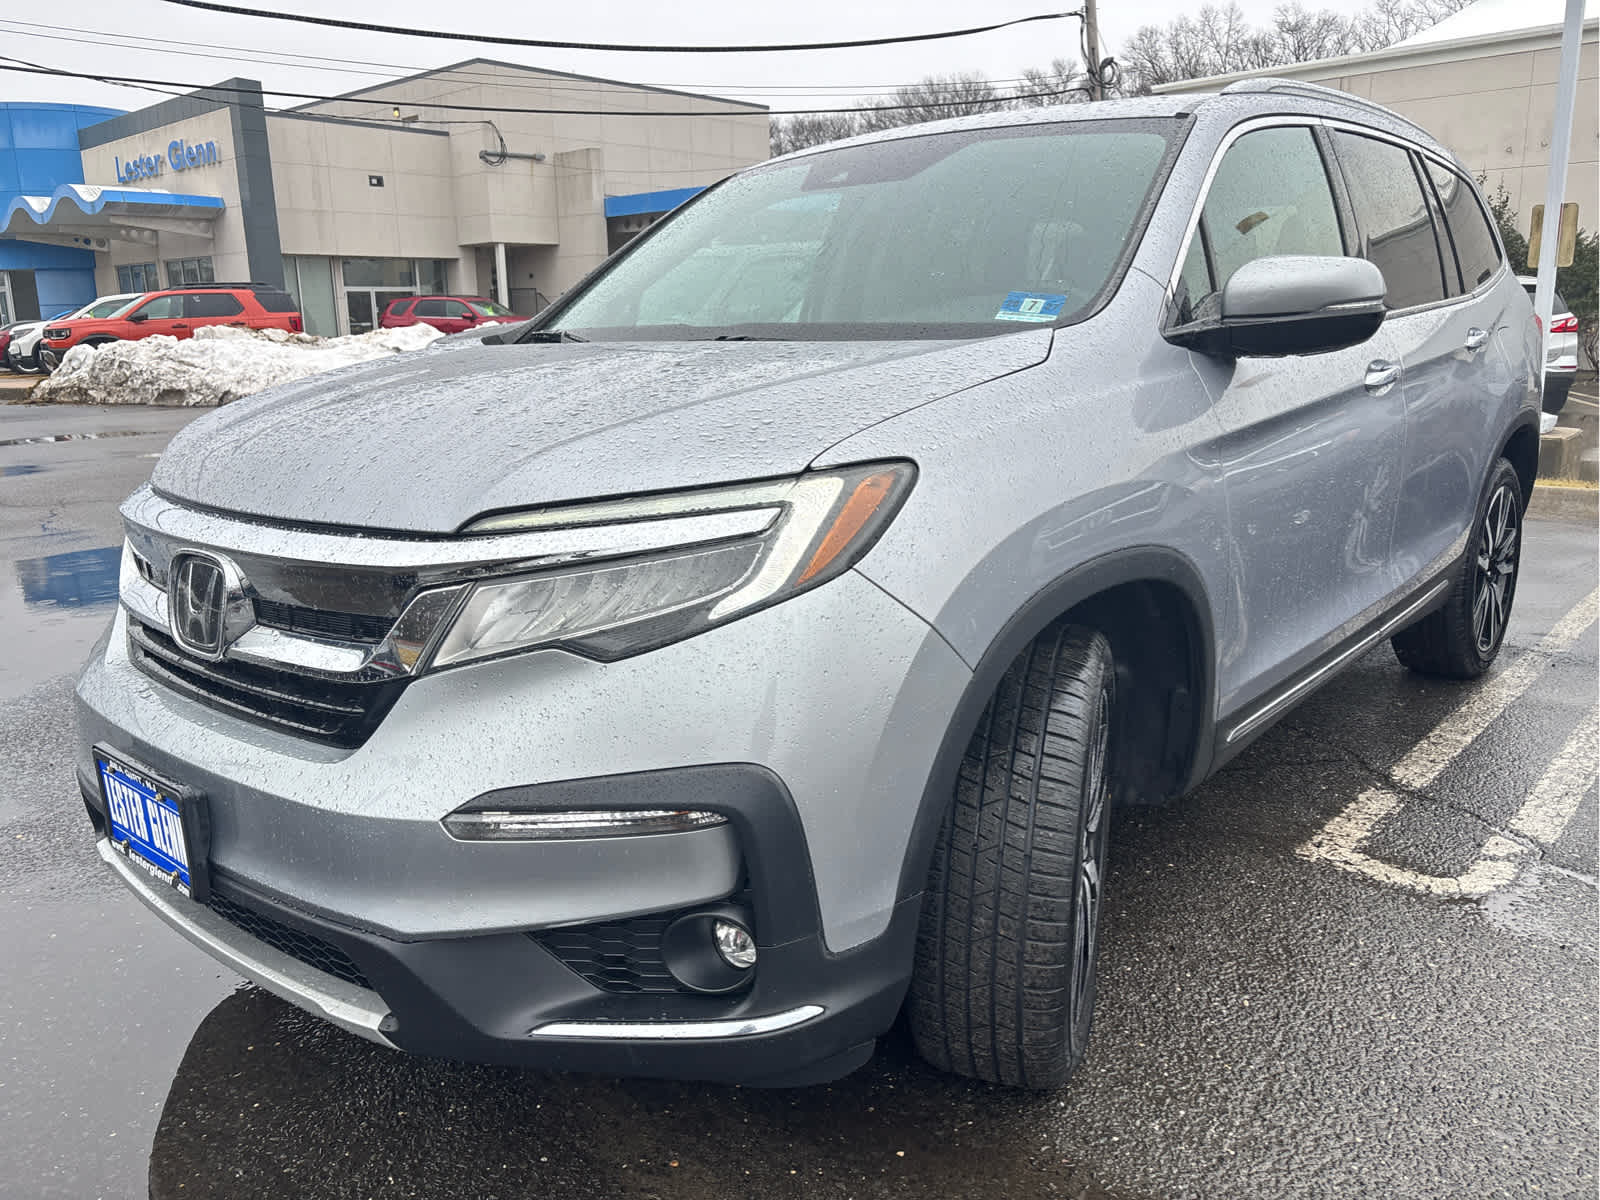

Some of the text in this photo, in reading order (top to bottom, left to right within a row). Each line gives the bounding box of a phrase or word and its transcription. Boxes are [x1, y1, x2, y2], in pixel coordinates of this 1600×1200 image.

[115, 139, 217, 183] Lester Glenn
[1028, 300, 1038, 311] 7
[103, 774, 188, 868] LESTER GLENN
